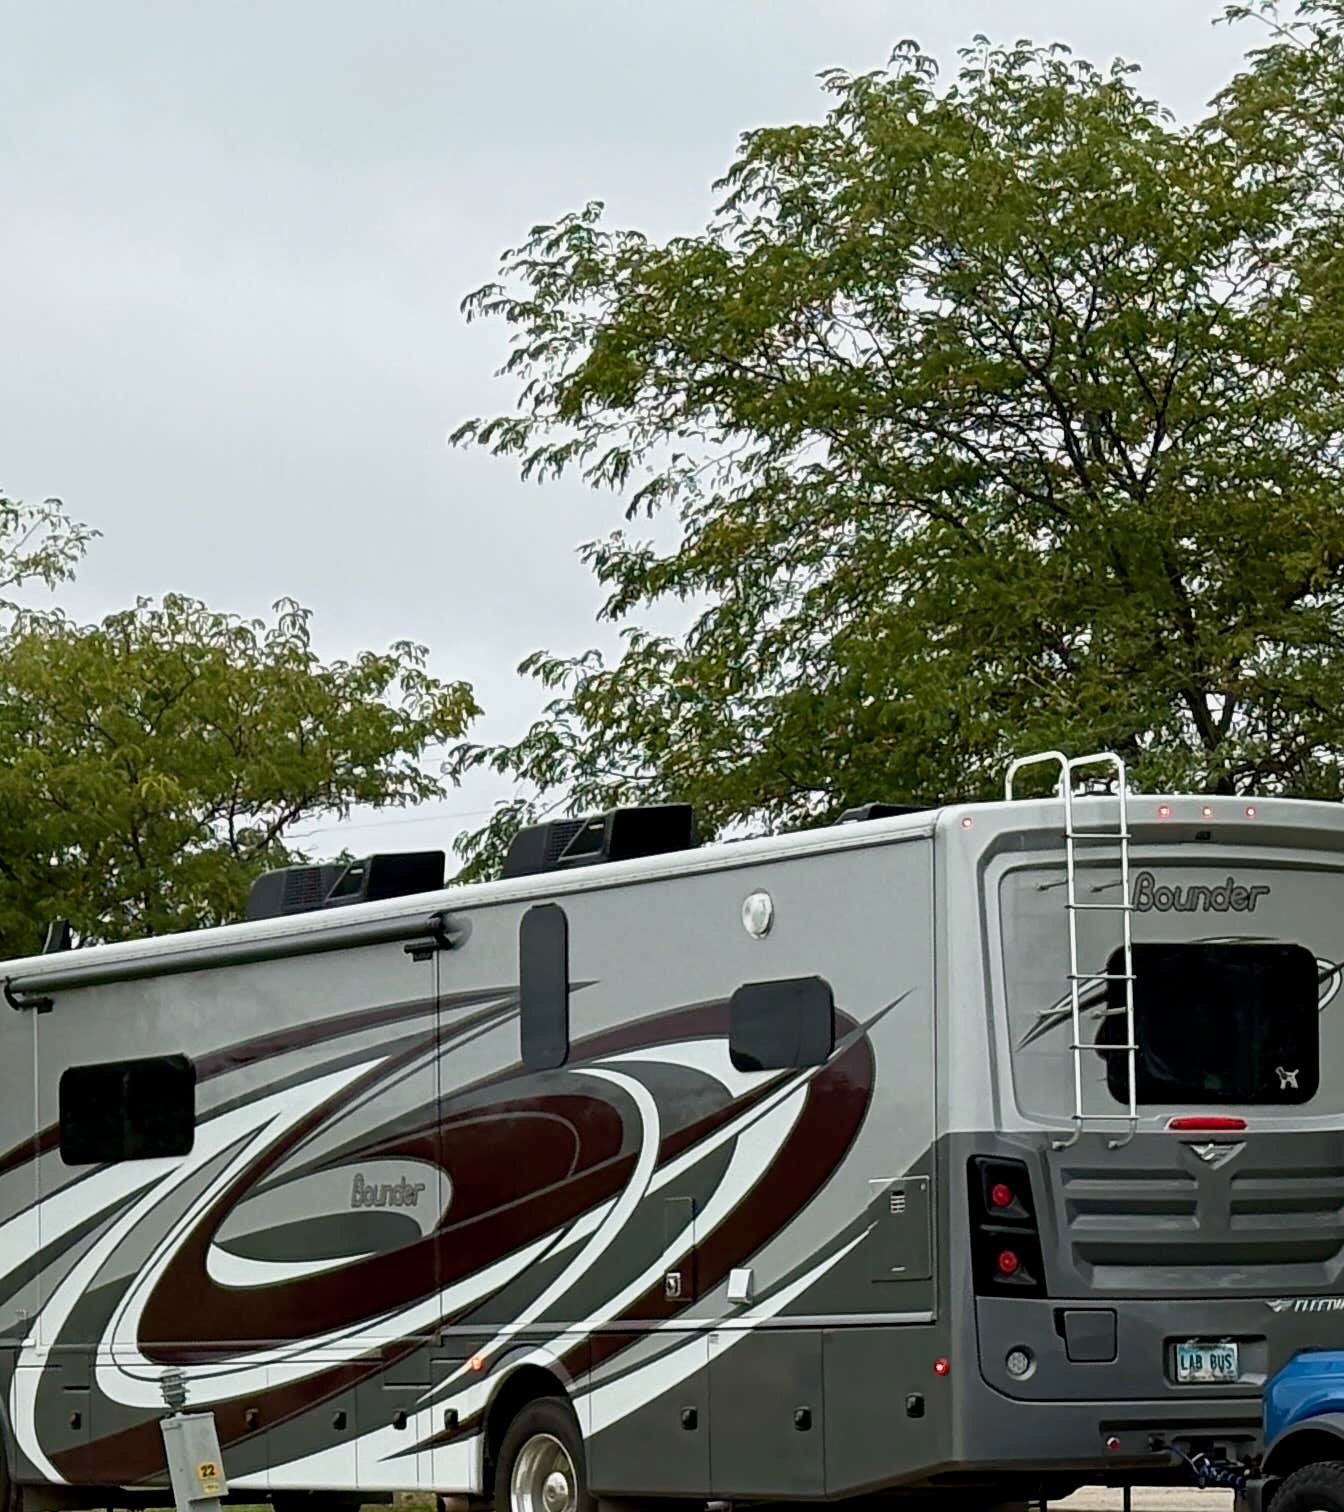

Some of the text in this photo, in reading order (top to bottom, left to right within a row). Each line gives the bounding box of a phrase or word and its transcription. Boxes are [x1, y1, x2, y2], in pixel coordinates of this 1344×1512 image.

[1132, 871, 1270, 912] Bounder
[351, 1172, 426, 1208] Bounder
[1180, 1352, 1233, 1371] LAB BUS
[200, 1464, 216, 1478] 22
